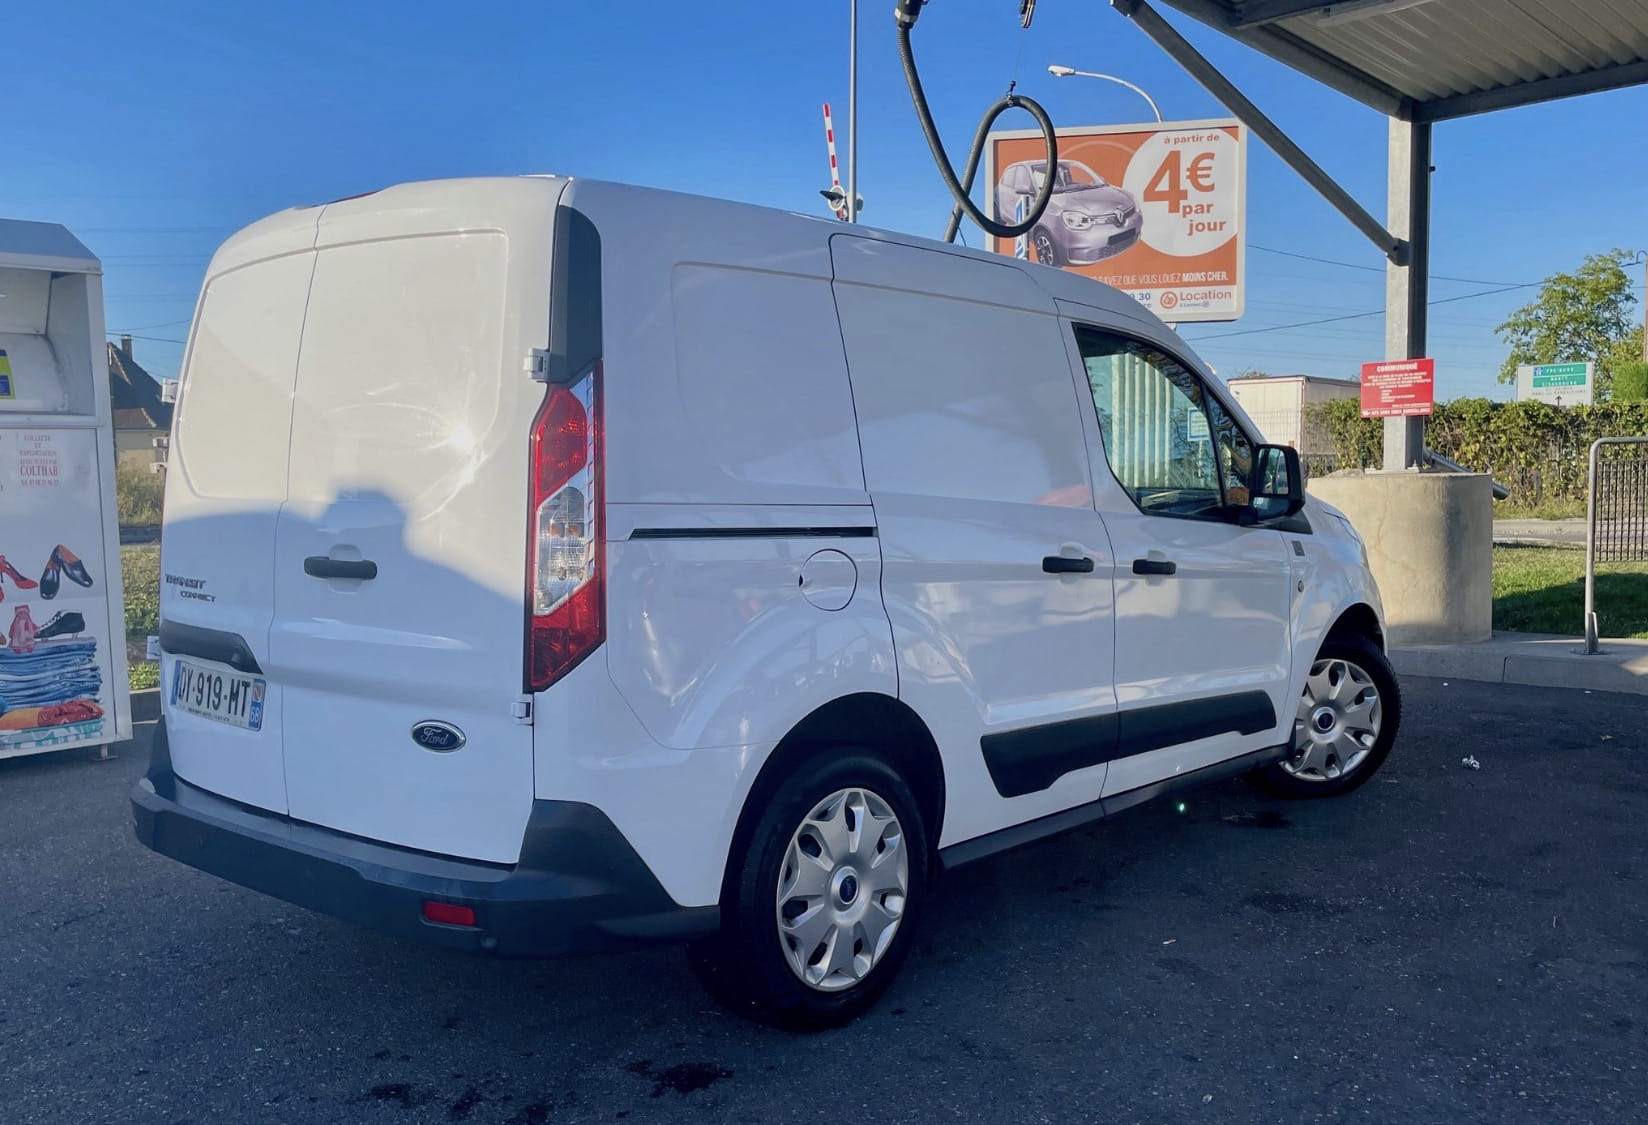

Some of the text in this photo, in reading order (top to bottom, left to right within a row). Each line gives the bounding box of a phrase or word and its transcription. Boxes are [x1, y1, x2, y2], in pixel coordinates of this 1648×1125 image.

[1163, 133, 1220, 145] à partir de
[1182, 203, 1214, 218] par
[1187, 219, 1227, 236] jour
[1139, 273, 1158, 285] VOUS
[1158, 272, 1181, 284] LOUEZ
[1182, 271, 1206, 283] MOINS
[1207, 270, 1229, 281] CHER.
[1138, 292, 1151, 301] 30
[1180, 290, 1232, 301] Location
[250, 706, 260, 723] 68
[421, 727, 449, 745] Ford
